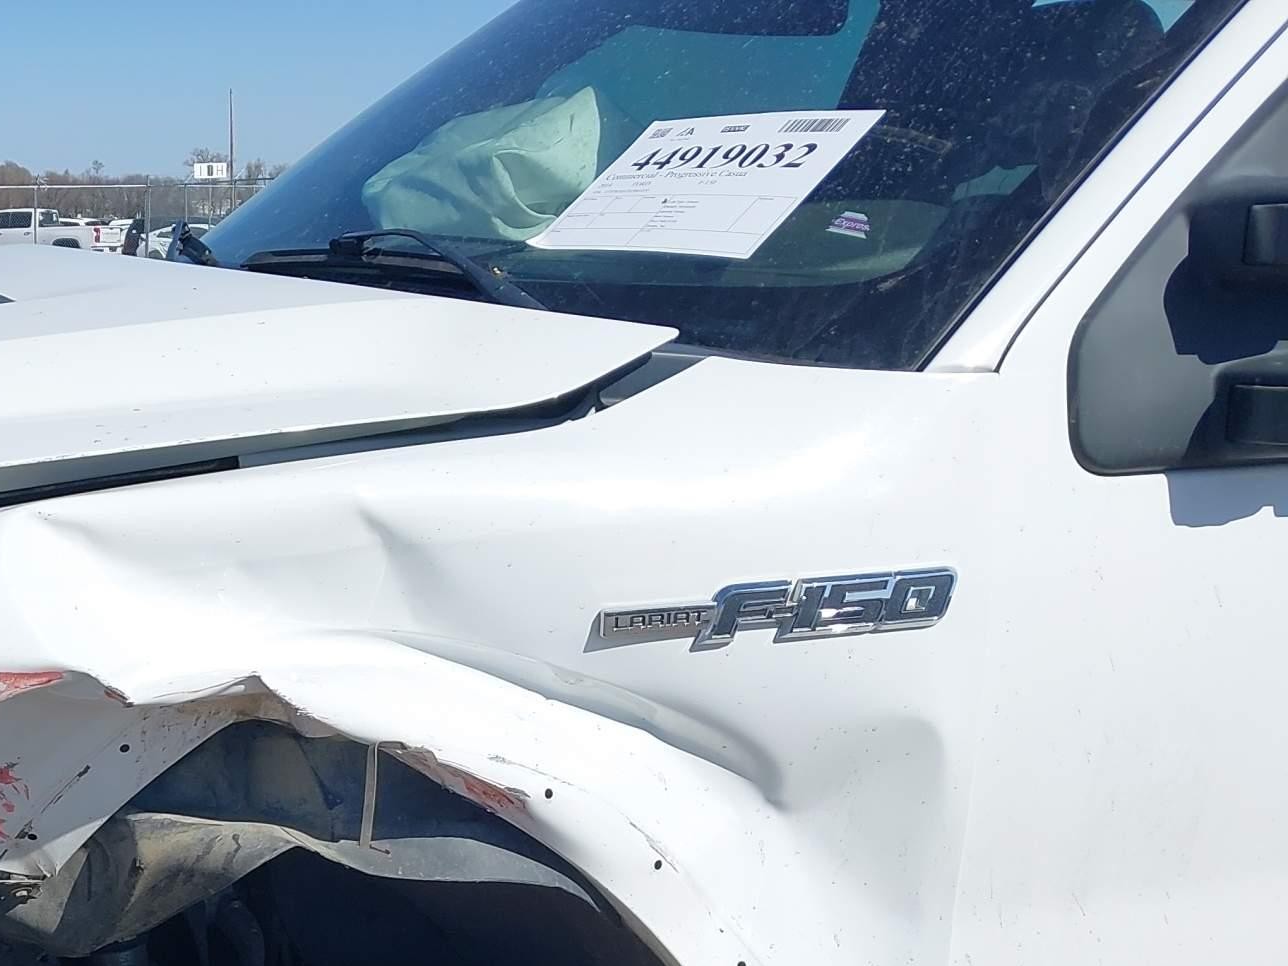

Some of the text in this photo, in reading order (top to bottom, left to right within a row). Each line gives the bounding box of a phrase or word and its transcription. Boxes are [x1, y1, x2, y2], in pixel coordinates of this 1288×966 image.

[631, 143, 818, 172] 44919032
[606, 171, 659, 182] Commercial
[665, 169, 718, 180] Progressive
[612, 566, 959, 653] LARIAT F-150
